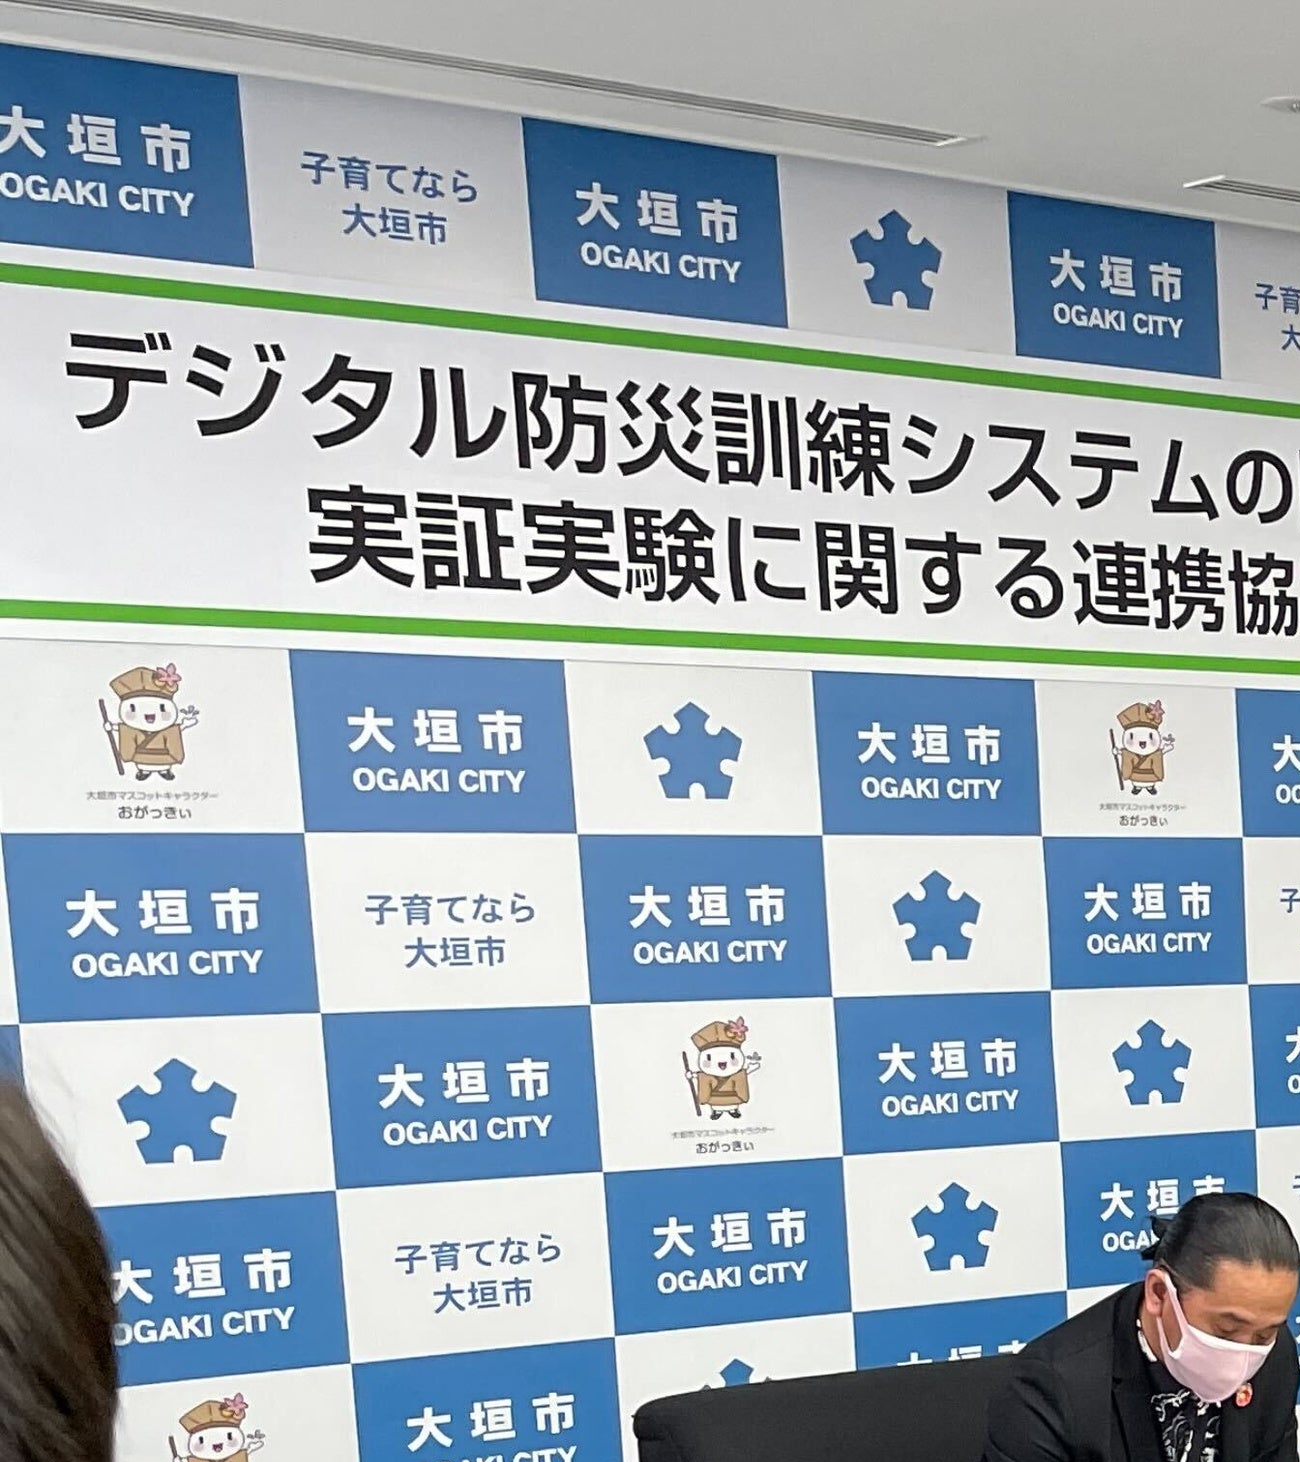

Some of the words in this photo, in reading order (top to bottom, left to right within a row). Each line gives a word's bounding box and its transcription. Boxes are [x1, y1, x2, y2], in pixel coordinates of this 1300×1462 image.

[0, 105, 191, 173] 大垣市
[0, 171, 109, 208] OGAKI
[118, 185, 195, 217] CITY
[300, 151, 478, 203] 子育てなら
[342, 202, 447, 245] 大垣市
[575, 181, 738, 244] 大垣市
[580, 241, 671, 275] OGAKI
[678, 254, 742, 283] CITY
[1049, 248, 1182, 303] 大垣市
[1053, 302, 1126, 332] OGAKI
[1132, 312, 1184, 339] CITY
[347, 706, 523, 755] 大垣市
[857, 722, 1001, 766] 大垣市
[86, 790, 218, 801] 大垣市マスコットキャラクター
[352, 767, 450, 792] OGAKI
[458, 769, 526, 793] CITY
[861, 776, 939, 799] OGAKI
[946, 778, 1002, 800] CITY
[117, 805, 193, 820] おがっきい
[1119, 815, 1169, 827] おがっきい
[65, 887, 259, 938] 大垣市
[364, 892, 535, 926] 子育てなら
[629, 884, 785, 929] 大垣市
[1084, 881, 1212, 922] 大垣市
[72, 951, 179, 978] OGAKI
[188, 949, 263, 975] CITY
[404, 935, 506, 968] 大垣市
[633, 940, 720, 965] OGAKI
[727, 939, 787, 963] CITY
[1086, 933, 1157, 955] OGAKI
[1162, 932, 1212, 953] CITY
[878, 1037, 1017, 1084] 大垣市
[378, 1057, 550, 1109] 大垣市
[881, 1092, 959, 1117] OGAKI
[965, 1089, 1019, 1112] CITY
[383, 1118, 478, 1146] OGAKI
[486, 1114, 553, 1140] CITY
[695, 1140, 755, 1155] おがっきい
[394, 1233, 561, 1275] 子育てなら
[653, 1207, 806, 1260] 大垣市
[112, 1248, 292, 1304] 大垣市
[433, 1276, 532, 1314] 大垣市
[657, 1266, 742, 1294] OGAKI
[749, 1259, 808, 1285] CITY
[117, 1314, 213, 1346] OGAKI
[222, 1306, 295, 1335] CITY
[406, 1392, 575, 1452] 大垣市
